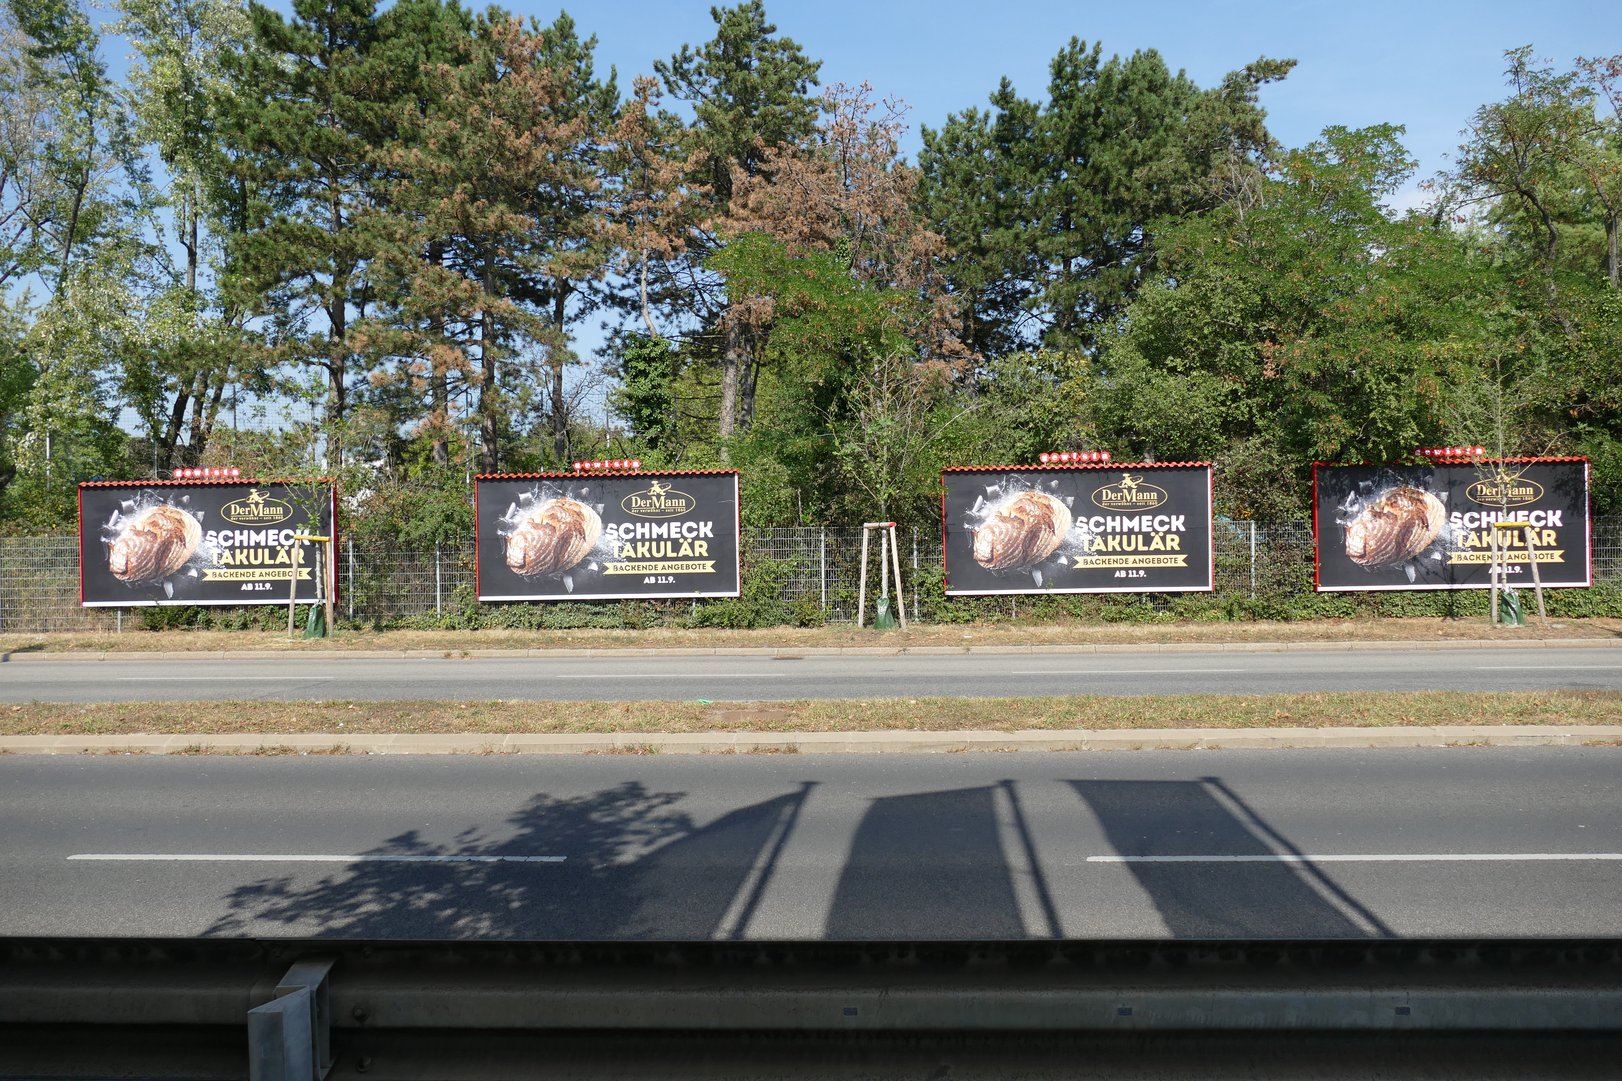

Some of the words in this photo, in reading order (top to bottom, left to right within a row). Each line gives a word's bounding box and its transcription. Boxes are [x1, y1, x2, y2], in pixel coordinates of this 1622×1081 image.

[605, 521, 714, 539] SCHMECK
[1075, 515, 1186, 532] SCHMECK
[205, 529, 310, 546] SCHMECK
[1082, 532, 1180, 552] TAKULÄR
[611, 538, 709, 558] TAKULÄR
[210, 546, 305, 565] TAKULÄR
[1083, 558, 1129, 566] BACKENDE
[1132, 557, 1179, 565] ANGEBOTE
[211, 570, 256, 578] BACKENDE
[258, 570, 303, 578] ANGEBOE
[612, 564, 658, 572] BACKENDE
[661, 563, 707, 571] ANGEBOTE
[1114, 570, 1126, 578] AB
[1128, 569, 1147, 578] 11.9.
[241, 583, 253, 591] AB
[254, 582, 273, 591] 11.9.
[643, 576, 656, 584] AB
[657, 576, 676, 584] 11.9.
